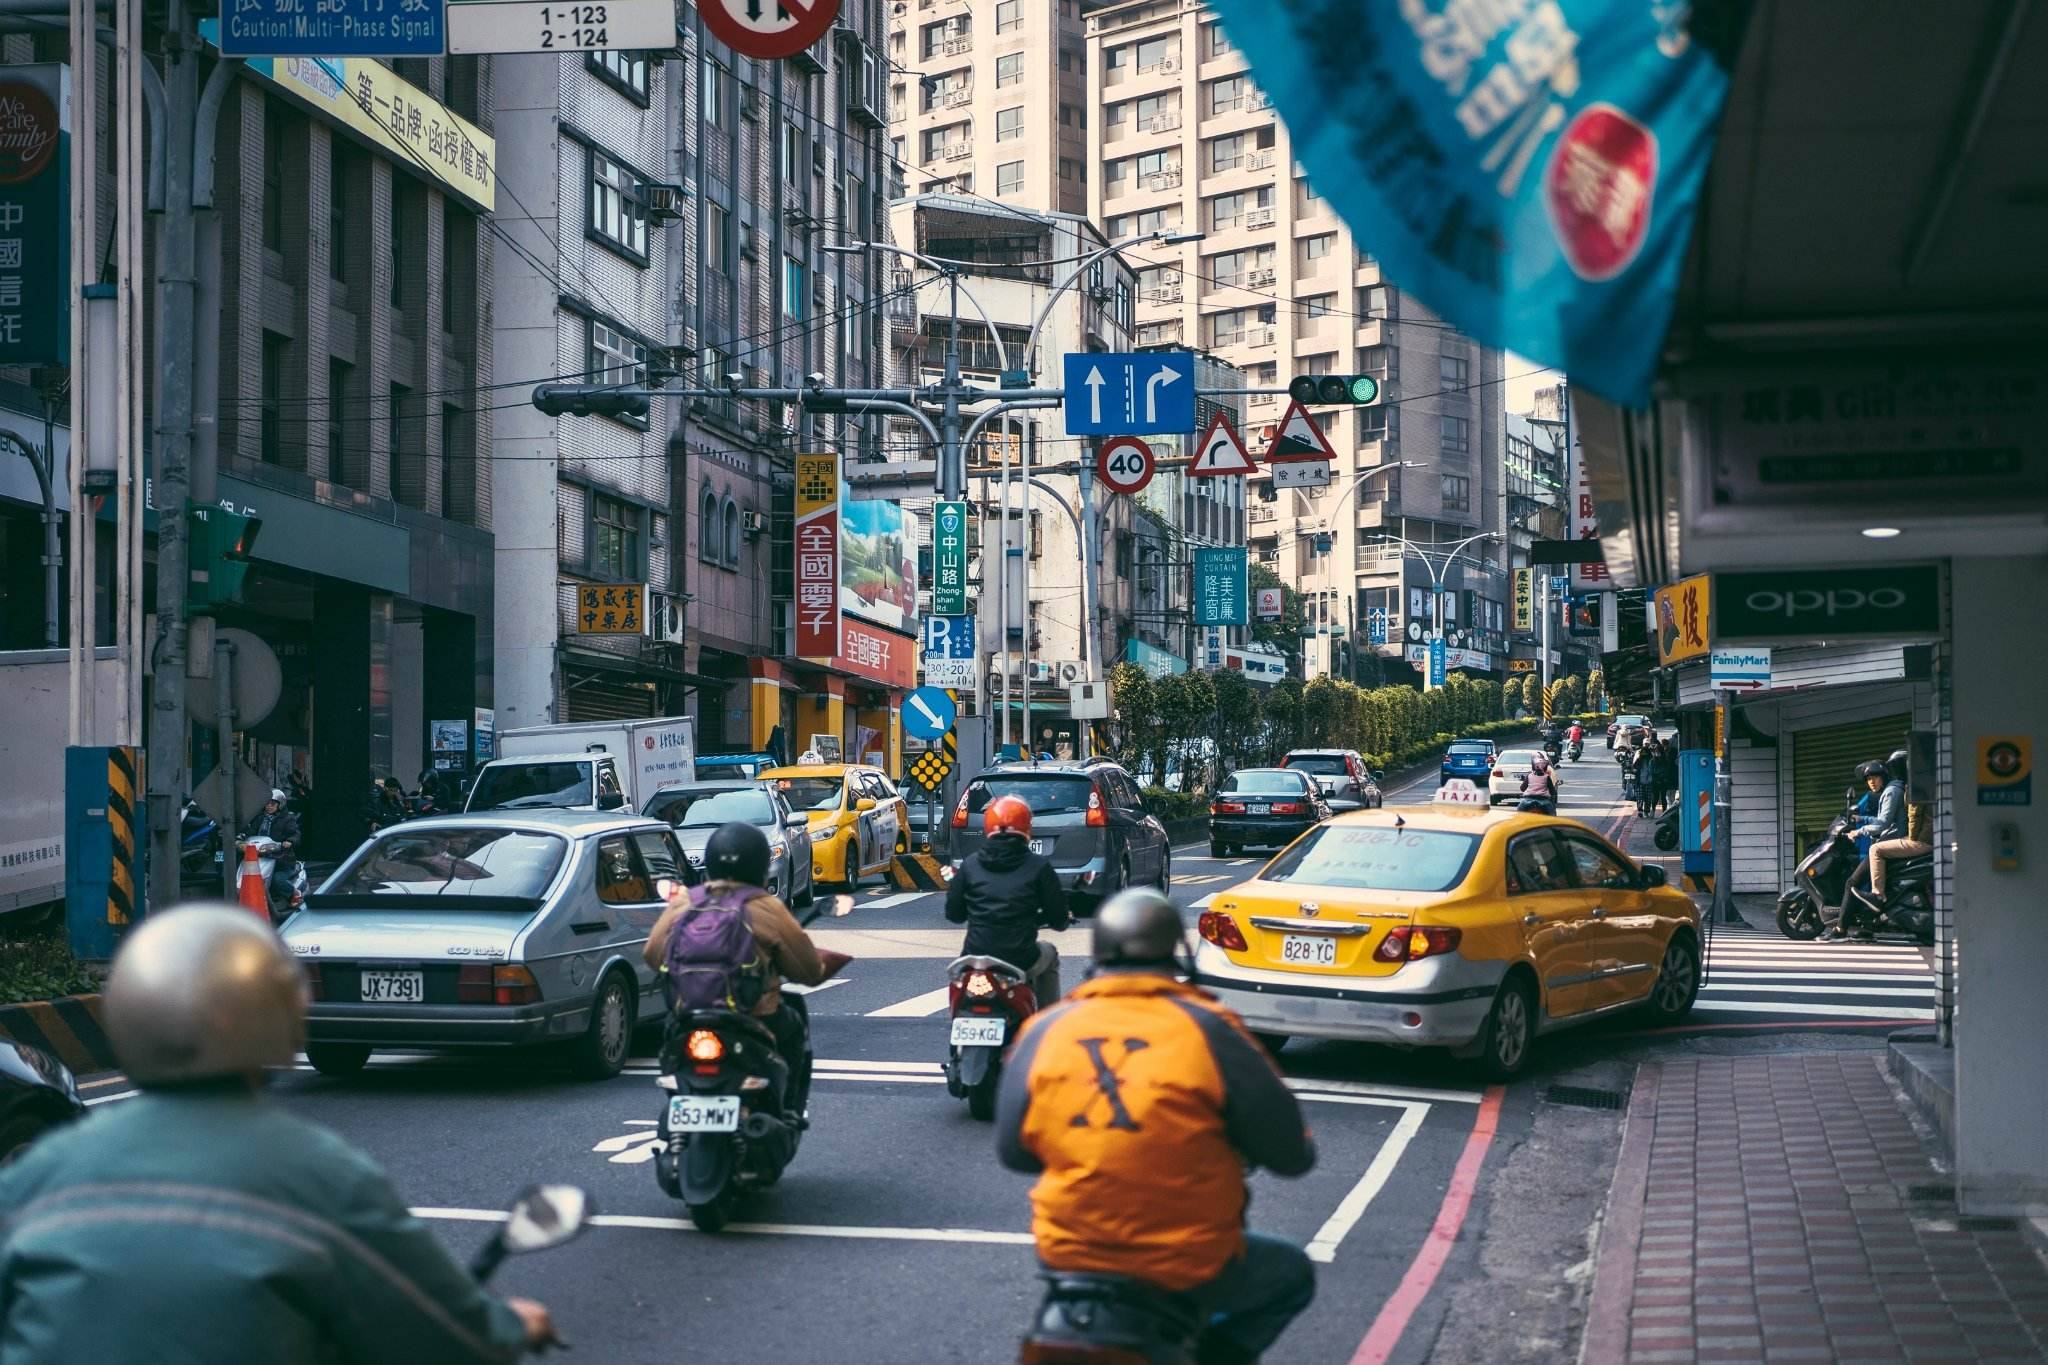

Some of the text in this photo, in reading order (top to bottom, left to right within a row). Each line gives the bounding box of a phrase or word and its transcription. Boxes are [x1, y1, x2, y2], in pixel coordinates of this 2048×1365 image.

[391, 15, 435, 41] Signal
[801, 461, 834, 475] 全國
[1110, 453, 1144, 475] 40
[942, 534, 958, 585] 中山路
[800, 525, 833, 636] 全國電子
[936, 587, 963, 596] Zhong-
[936, 596, 954, 604] shan
[583, 610, 639, 630] 中藥房
[928, 616, 951, 650] P
[846, 629, 891, 671] 全國電子
[1712, 654, 1769, 668] FamilyMart
[1440, 791, 1479, 802] TAXI
[1341, 831, 1423, 848] 828-YC
[473, 945, 505, 957] turbo
[1285, 941, 1334, 962] 828-YC
[1068, 1036, 1150, 1134] X
[671, 1107, 736, 1126] 853-MWY
